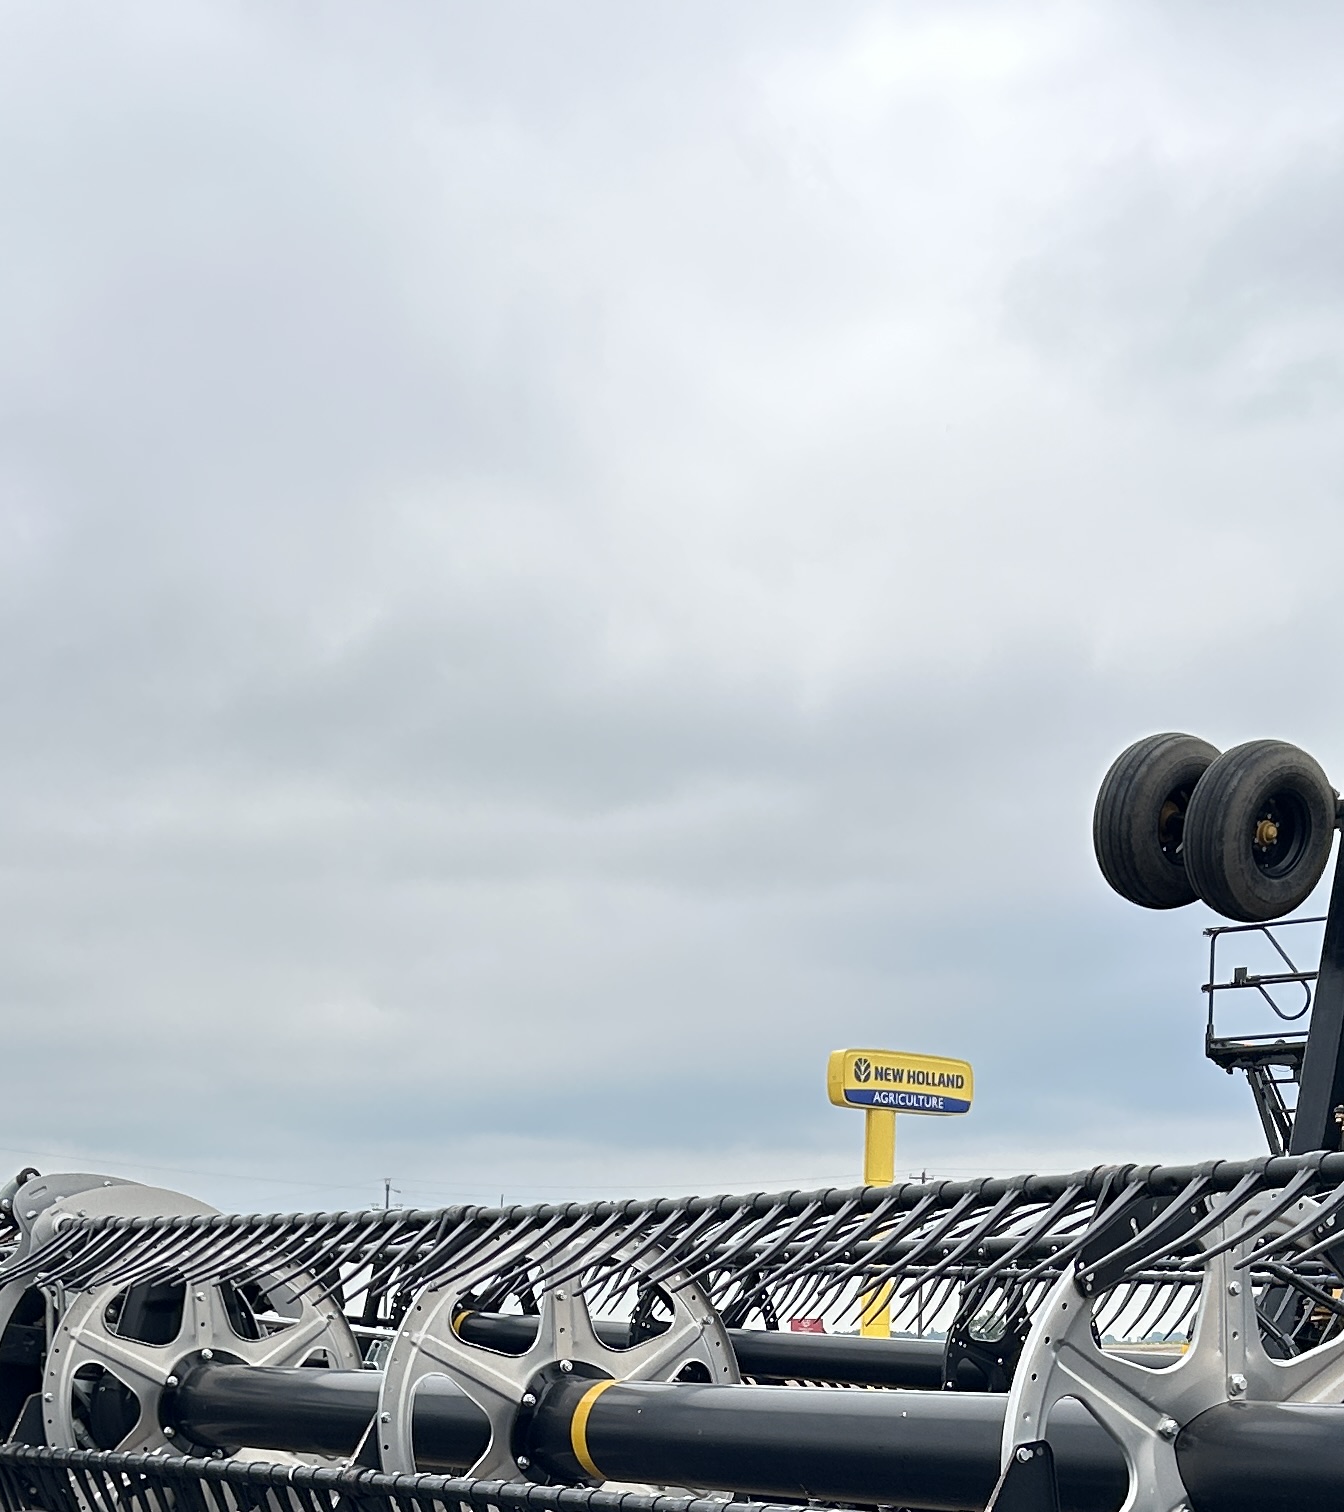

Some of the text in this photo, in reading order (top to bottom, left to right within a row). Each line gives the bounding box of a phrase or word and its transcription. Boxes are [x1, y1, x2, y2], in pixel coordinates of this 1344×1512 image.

[874, 1065, 964, 1089] NEW HOLLAND
[872, 1091, 944, 1109] AGRICULTURE
